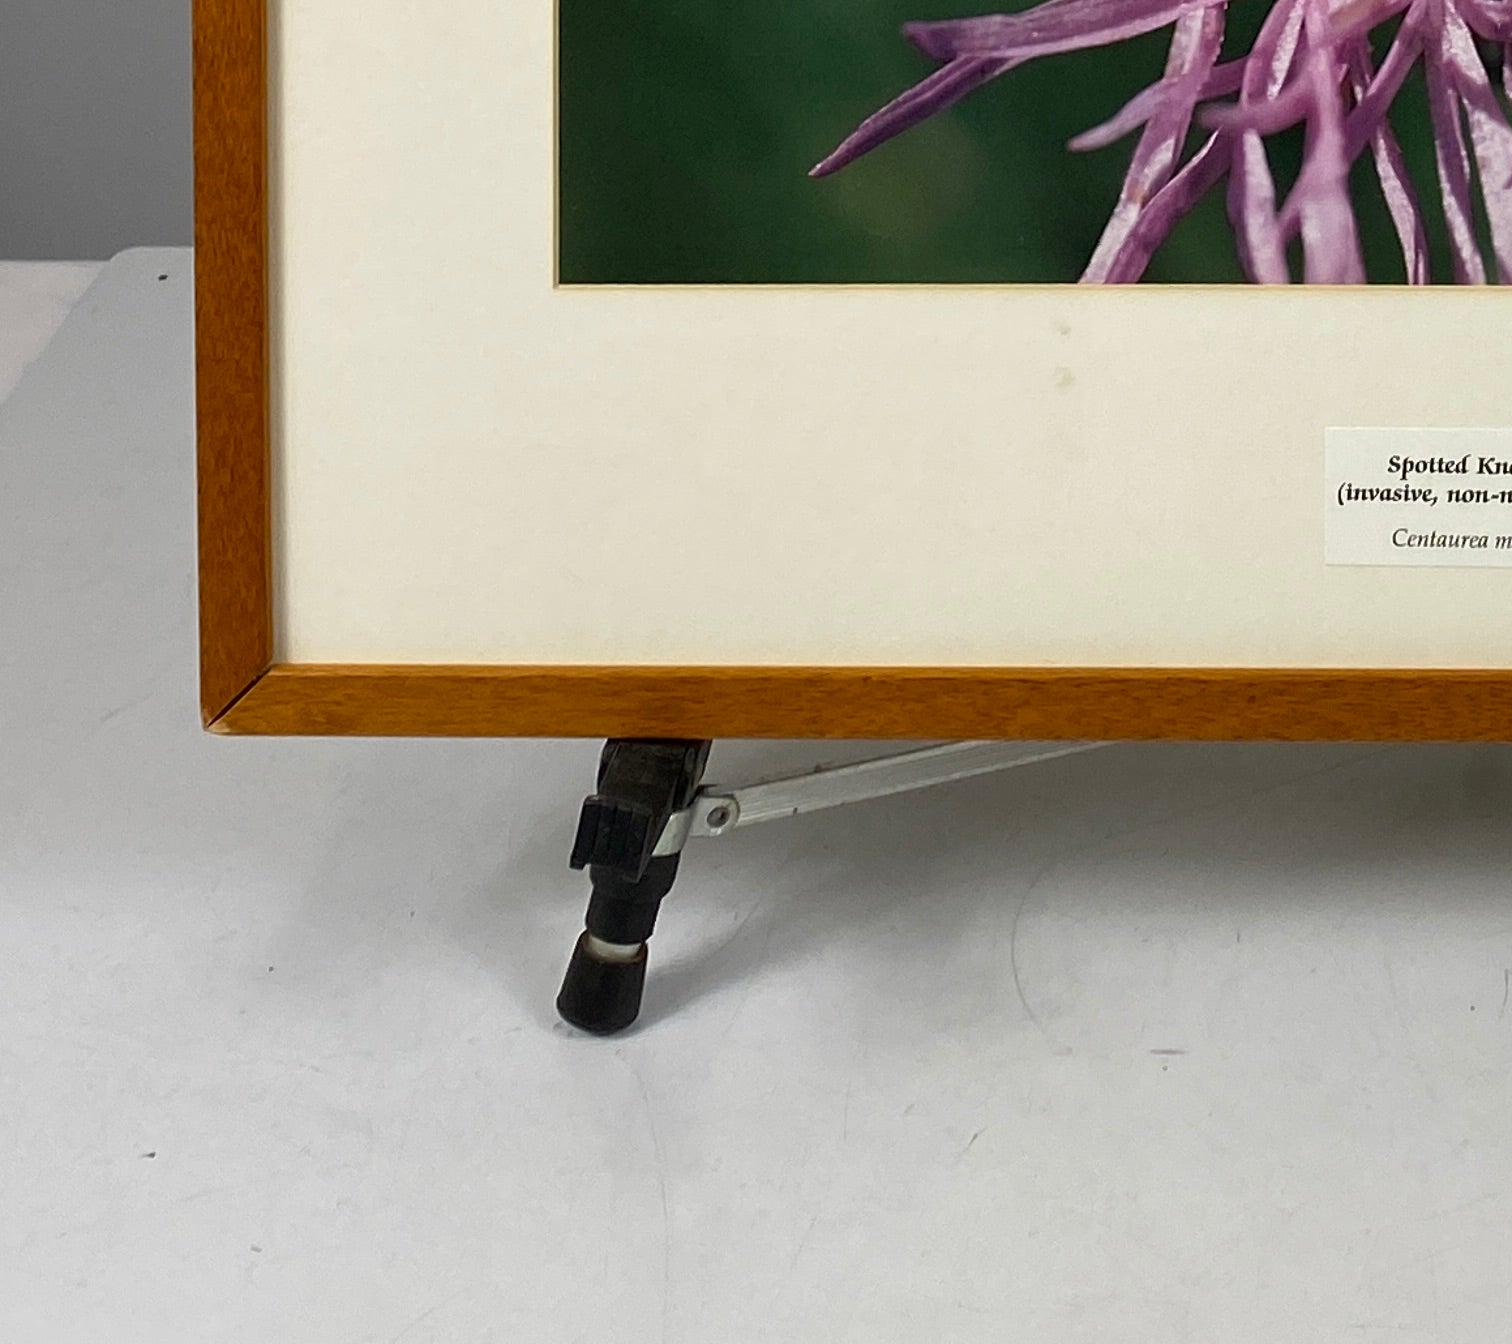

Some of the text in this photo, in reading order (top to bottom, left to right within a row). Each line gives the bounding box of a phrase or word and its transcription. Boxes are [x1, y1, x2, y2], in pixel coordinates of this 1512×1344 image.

[1387, 454, 1472, 480] Spotted
[1337, 481, 1439, 508] (invasive,
[1392, 527, 1489, 549] Centaurea
